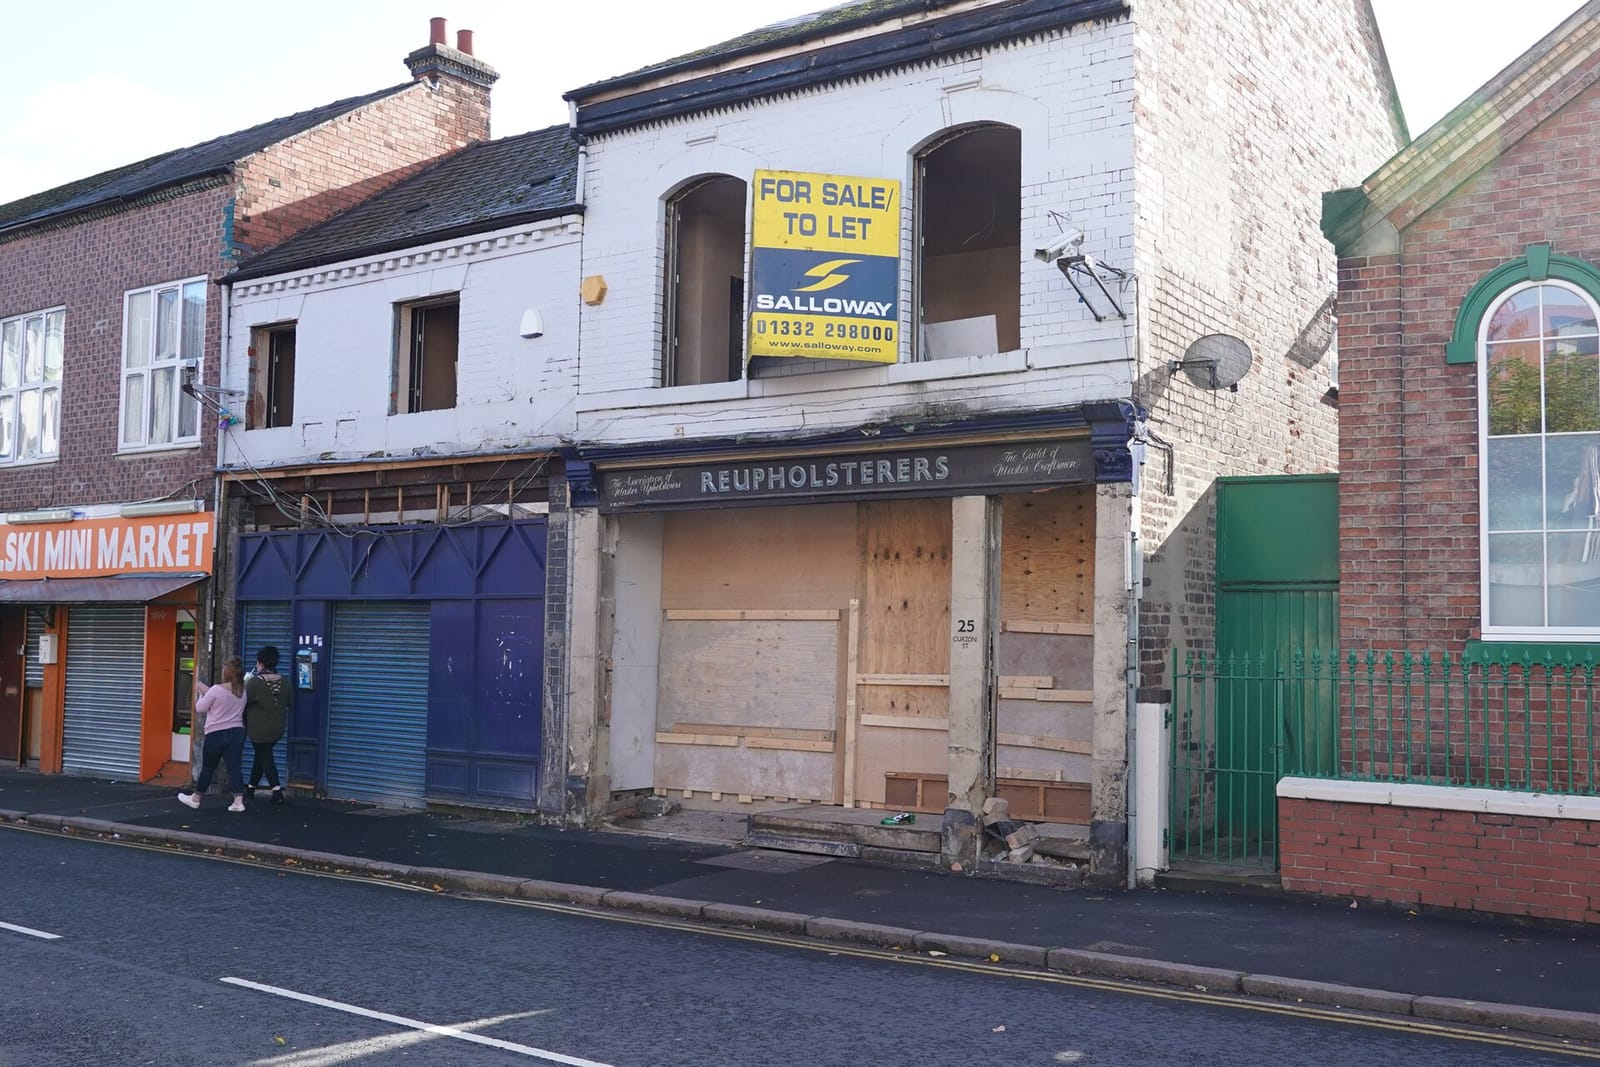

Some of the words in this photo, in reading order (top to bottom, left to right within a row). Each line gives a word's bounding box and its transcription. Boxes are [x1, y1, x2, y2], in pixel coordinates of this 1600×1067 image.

[760, 178, 811, 204] FOR
[822, 182, 894, 213] SALE/
[783, 212, 817, 236] TO
[828, 215, 872, 240] LET
[756, 294, 893, 317] SALLOWAY
[757, 320, 814, 337] 01332
[825, 323, 893, 342] 298000
[769, 340, 881, 354] www.salloway.com
[1001, 451, 1018, 463] The
[1022, 447, 1047, 460] Guild
[1049, 445, 1060, 460] of
[700, 455, 949, 494] REUPHOLSTERERS
[993, 463, 1029, 477] Master
[1034, 459, 1081, 475] Craftsmen
[609, 478, 622, 489] The
[665, 470, 673, 482] of
[43, 528, 93, 571] MINI
[97, 522, 209, 570] MARKET
[957, 619, 975, 633] 25
